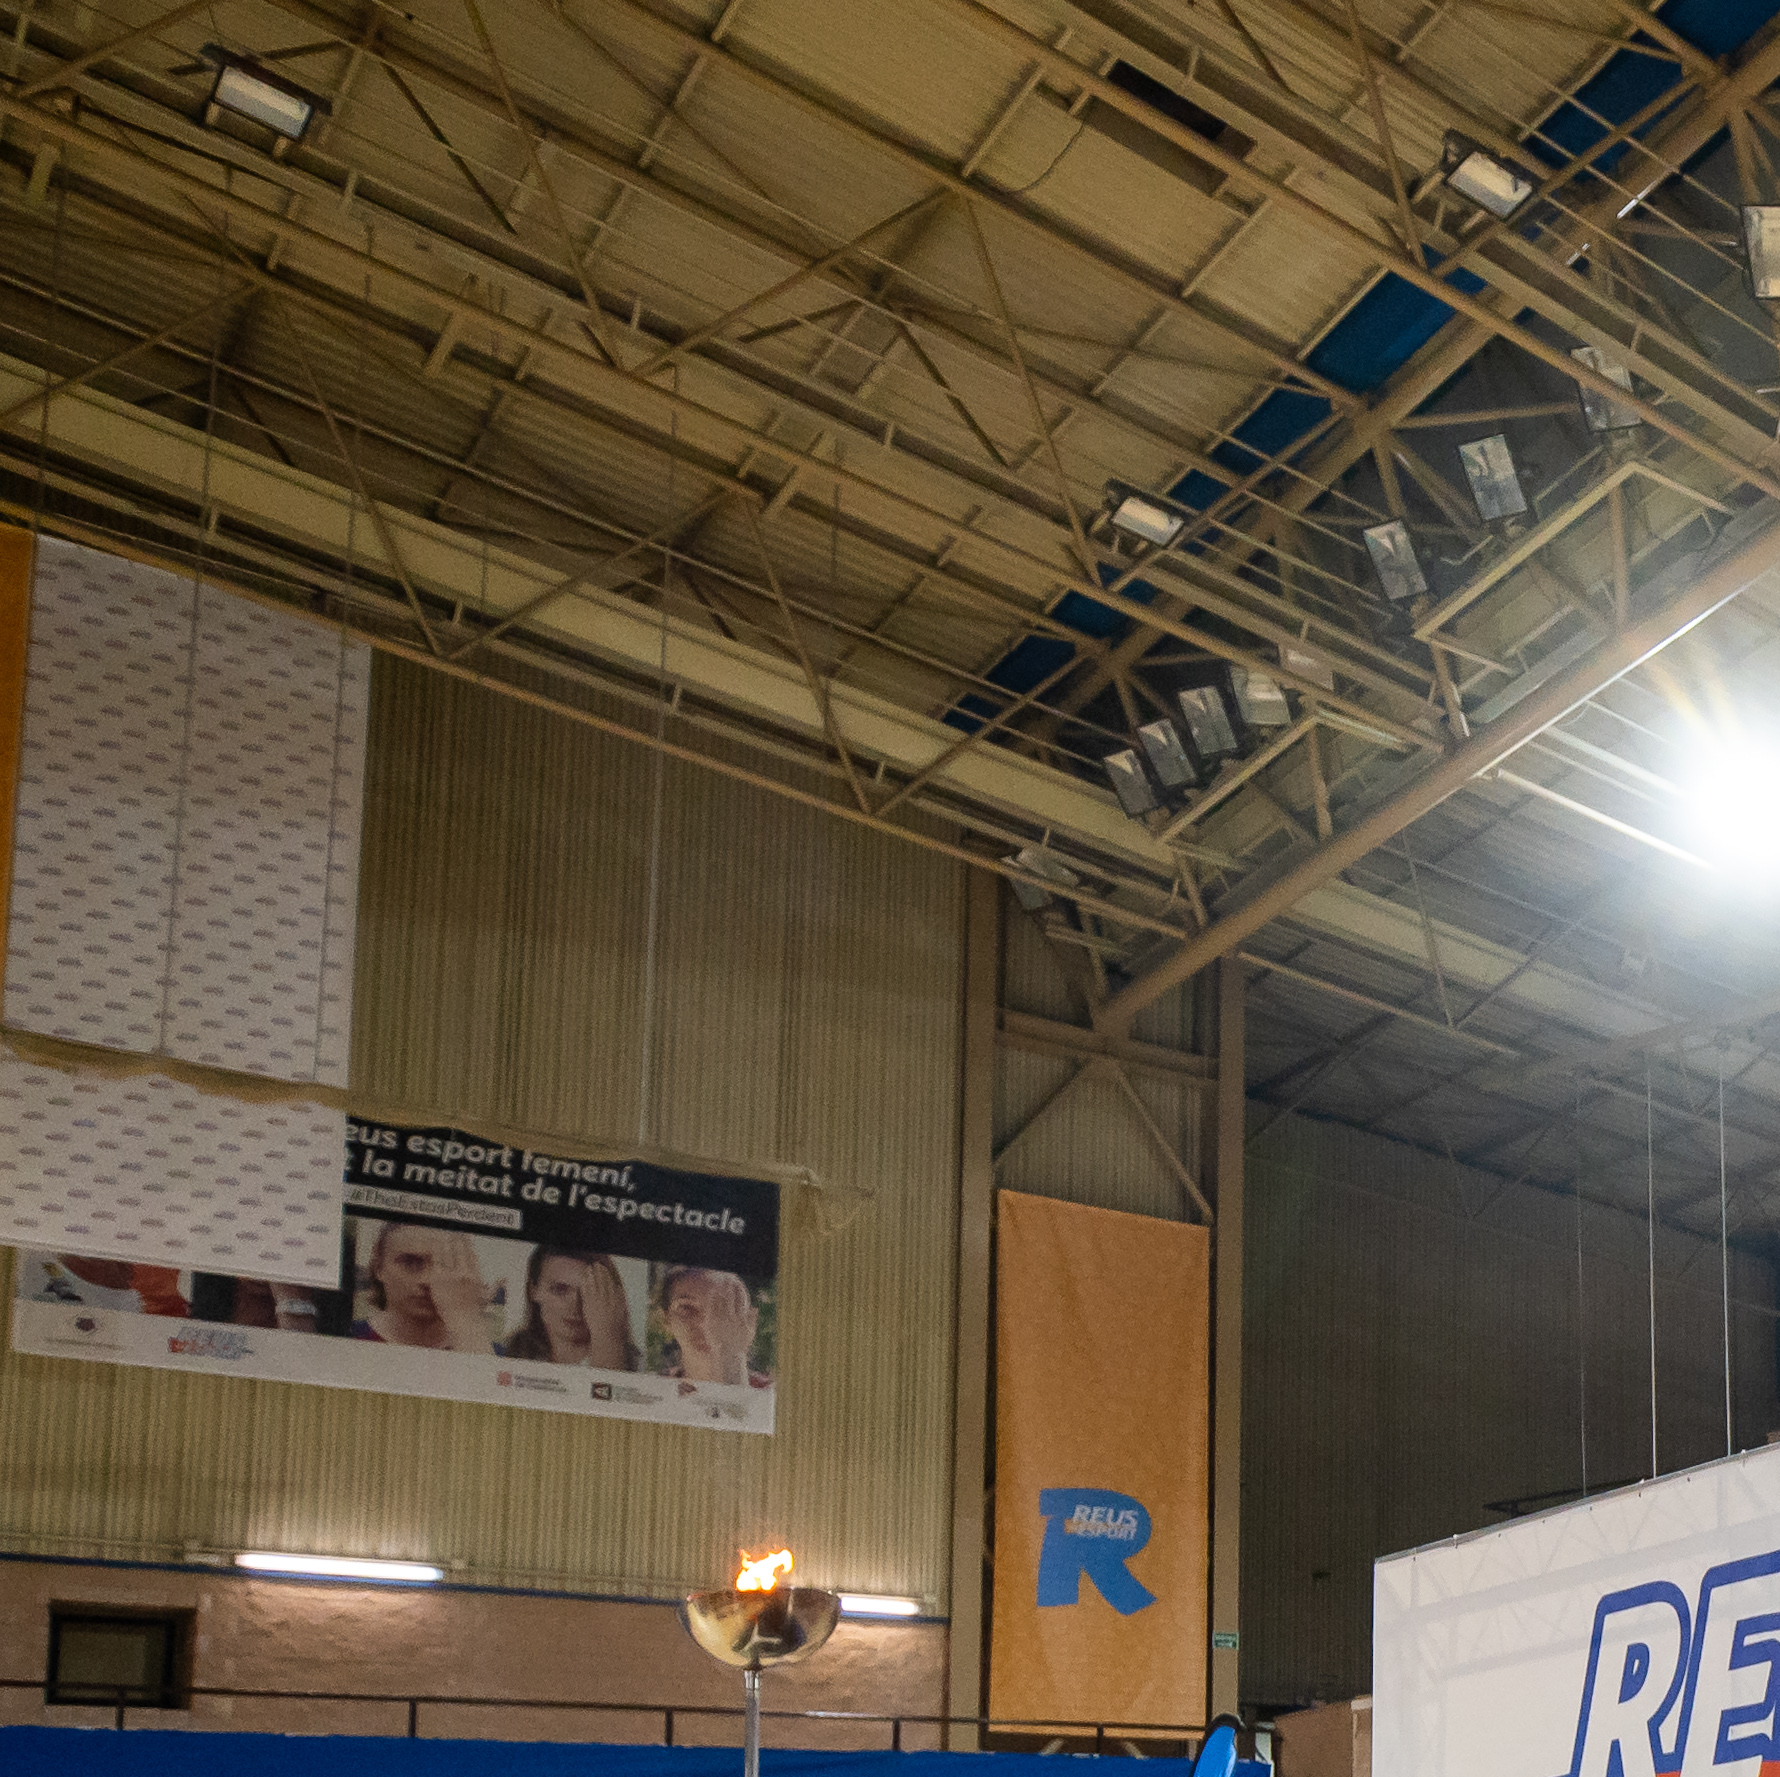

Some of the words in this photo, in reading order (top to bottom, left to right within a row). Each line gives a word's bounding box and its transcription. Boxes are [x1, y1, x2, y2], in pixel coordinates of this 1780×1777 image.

[346, 1124, 398, 1148] eus
[406, 1135, 514, 1169] esport
[362, 1148, 396, 1177] la
[403, 1162, 514, 1198] meitat
[521, 1177, 561, 1205] de
[568, 1183, 746, 1235] l'espectacle
[1072, 1504, 1138, 1528] REUS
